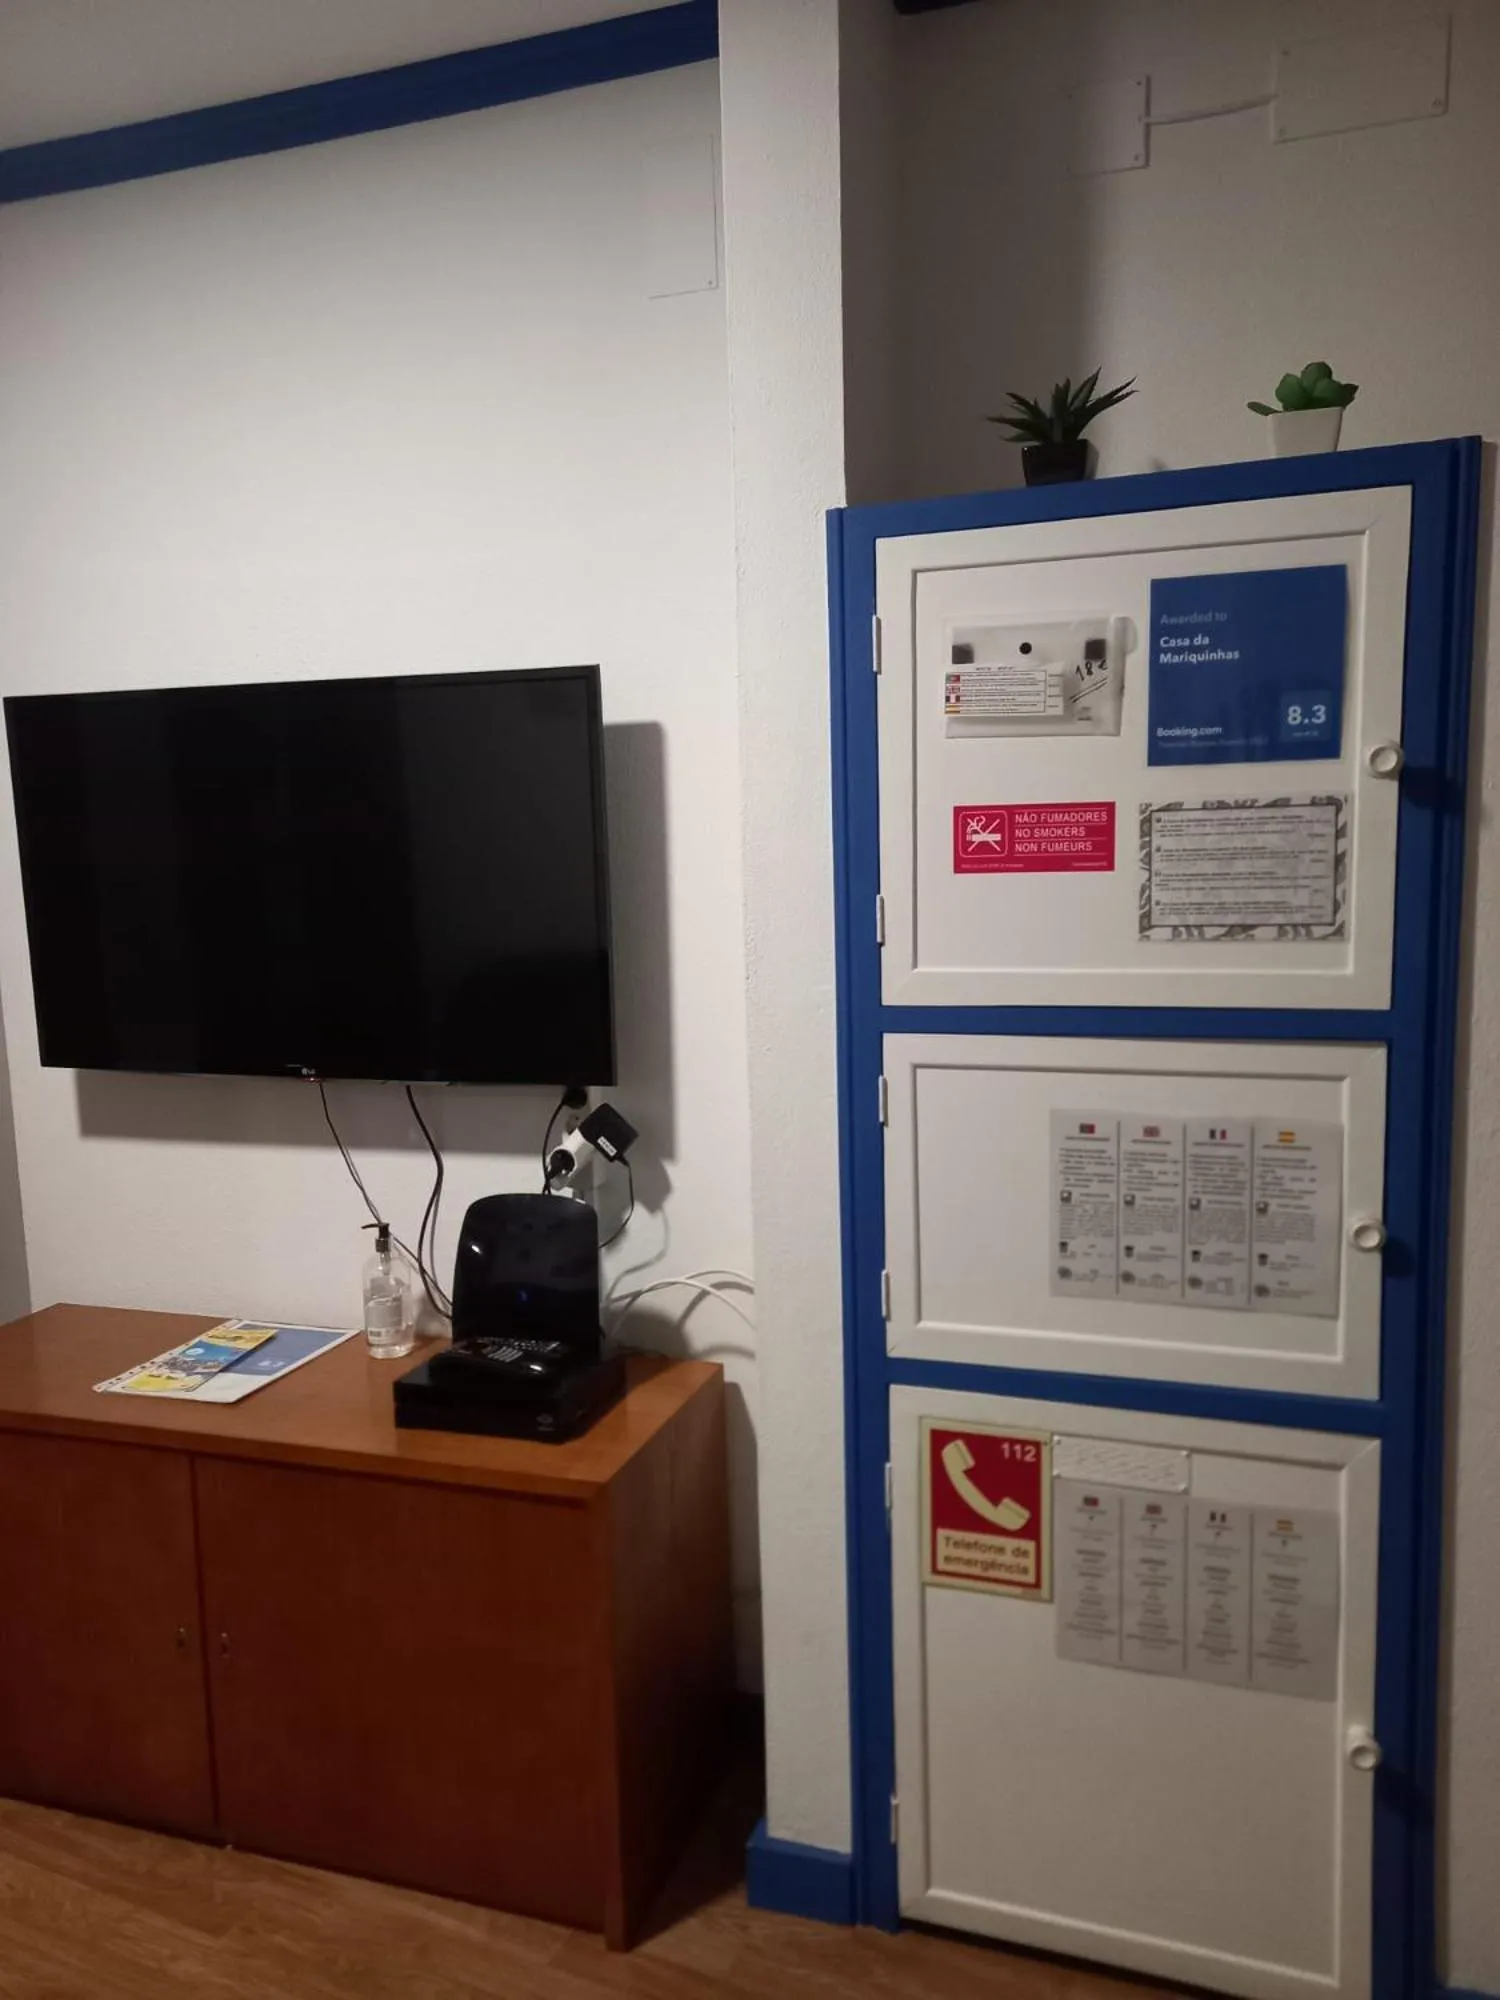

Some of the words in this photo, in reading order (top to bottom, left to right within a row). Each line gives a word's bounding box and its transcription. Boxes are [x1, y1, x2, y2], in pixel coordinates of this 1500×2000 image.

[1159, 635, 1190, 648] Casa
[1193, 634, 1210, 646] da
[1159, 649, 1240, 664] Mariquinhas
[1287, 704, 1327, 725] 8.3
[1157, 726, 1222, 737] Booking.com
[1015, 812, 1037, 823] NÃO
[1041, 811, 1108, 822] FUMADORES
[1015, 828, 1031, 838] NO
[1034, 826, 1086, 837] SMOKERS
[1015, 843, 1038, 852] NON
[1041, 841, 1092, 851] FUMEURS
[1001, 1442, 1037, 1462] 112
[944, 1536, 1006, 1555] Telefone
[1011, 1545, 1030, 1558] de
[943, 1555, 1030, 1575] emergência
